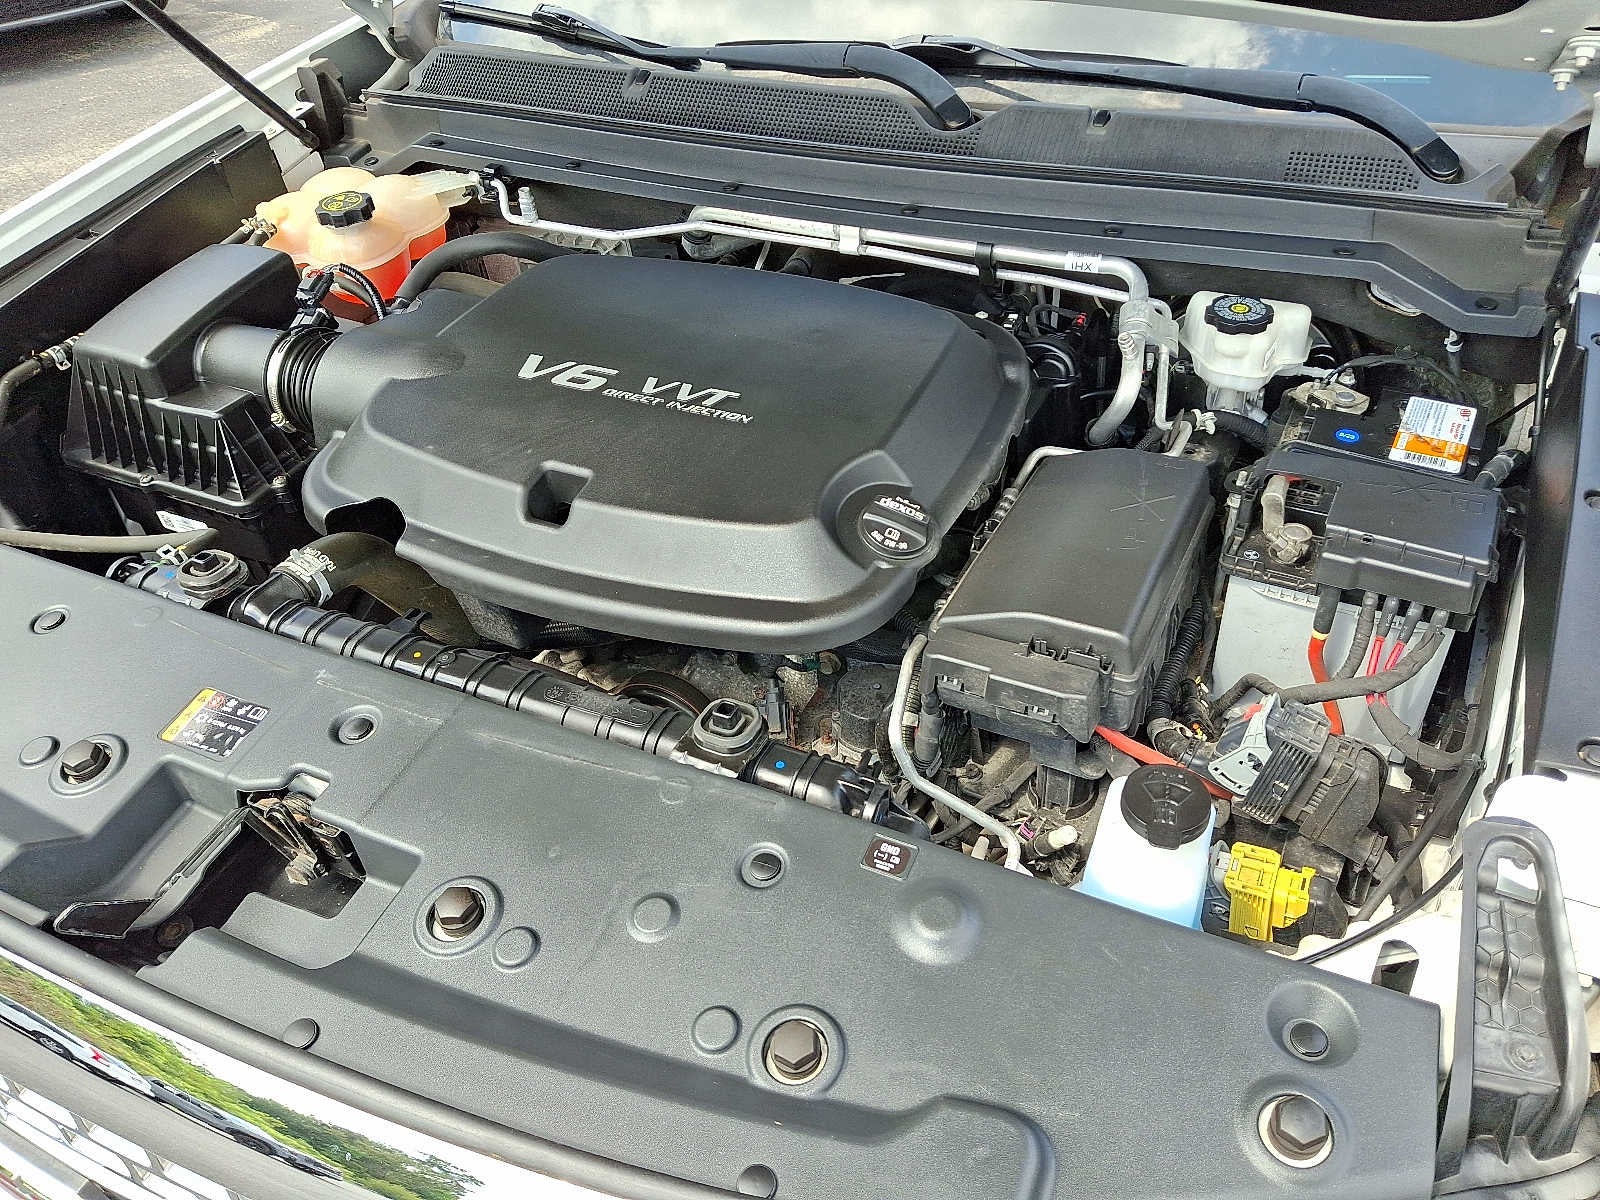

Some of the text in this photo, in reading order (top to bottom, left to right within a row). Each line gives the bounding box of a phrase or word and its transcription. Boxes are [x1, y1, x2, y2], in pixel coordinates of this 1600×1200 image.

[517, 353, 620, 392] V6
[641, 376, 742, 407] VVT
[601, 387, 754, 424] DIRECT INJECTION
[879, 497, 926, 521] dexos
[318, 554, 337, 572] RAD
[880, 842, 901, 856] GND
